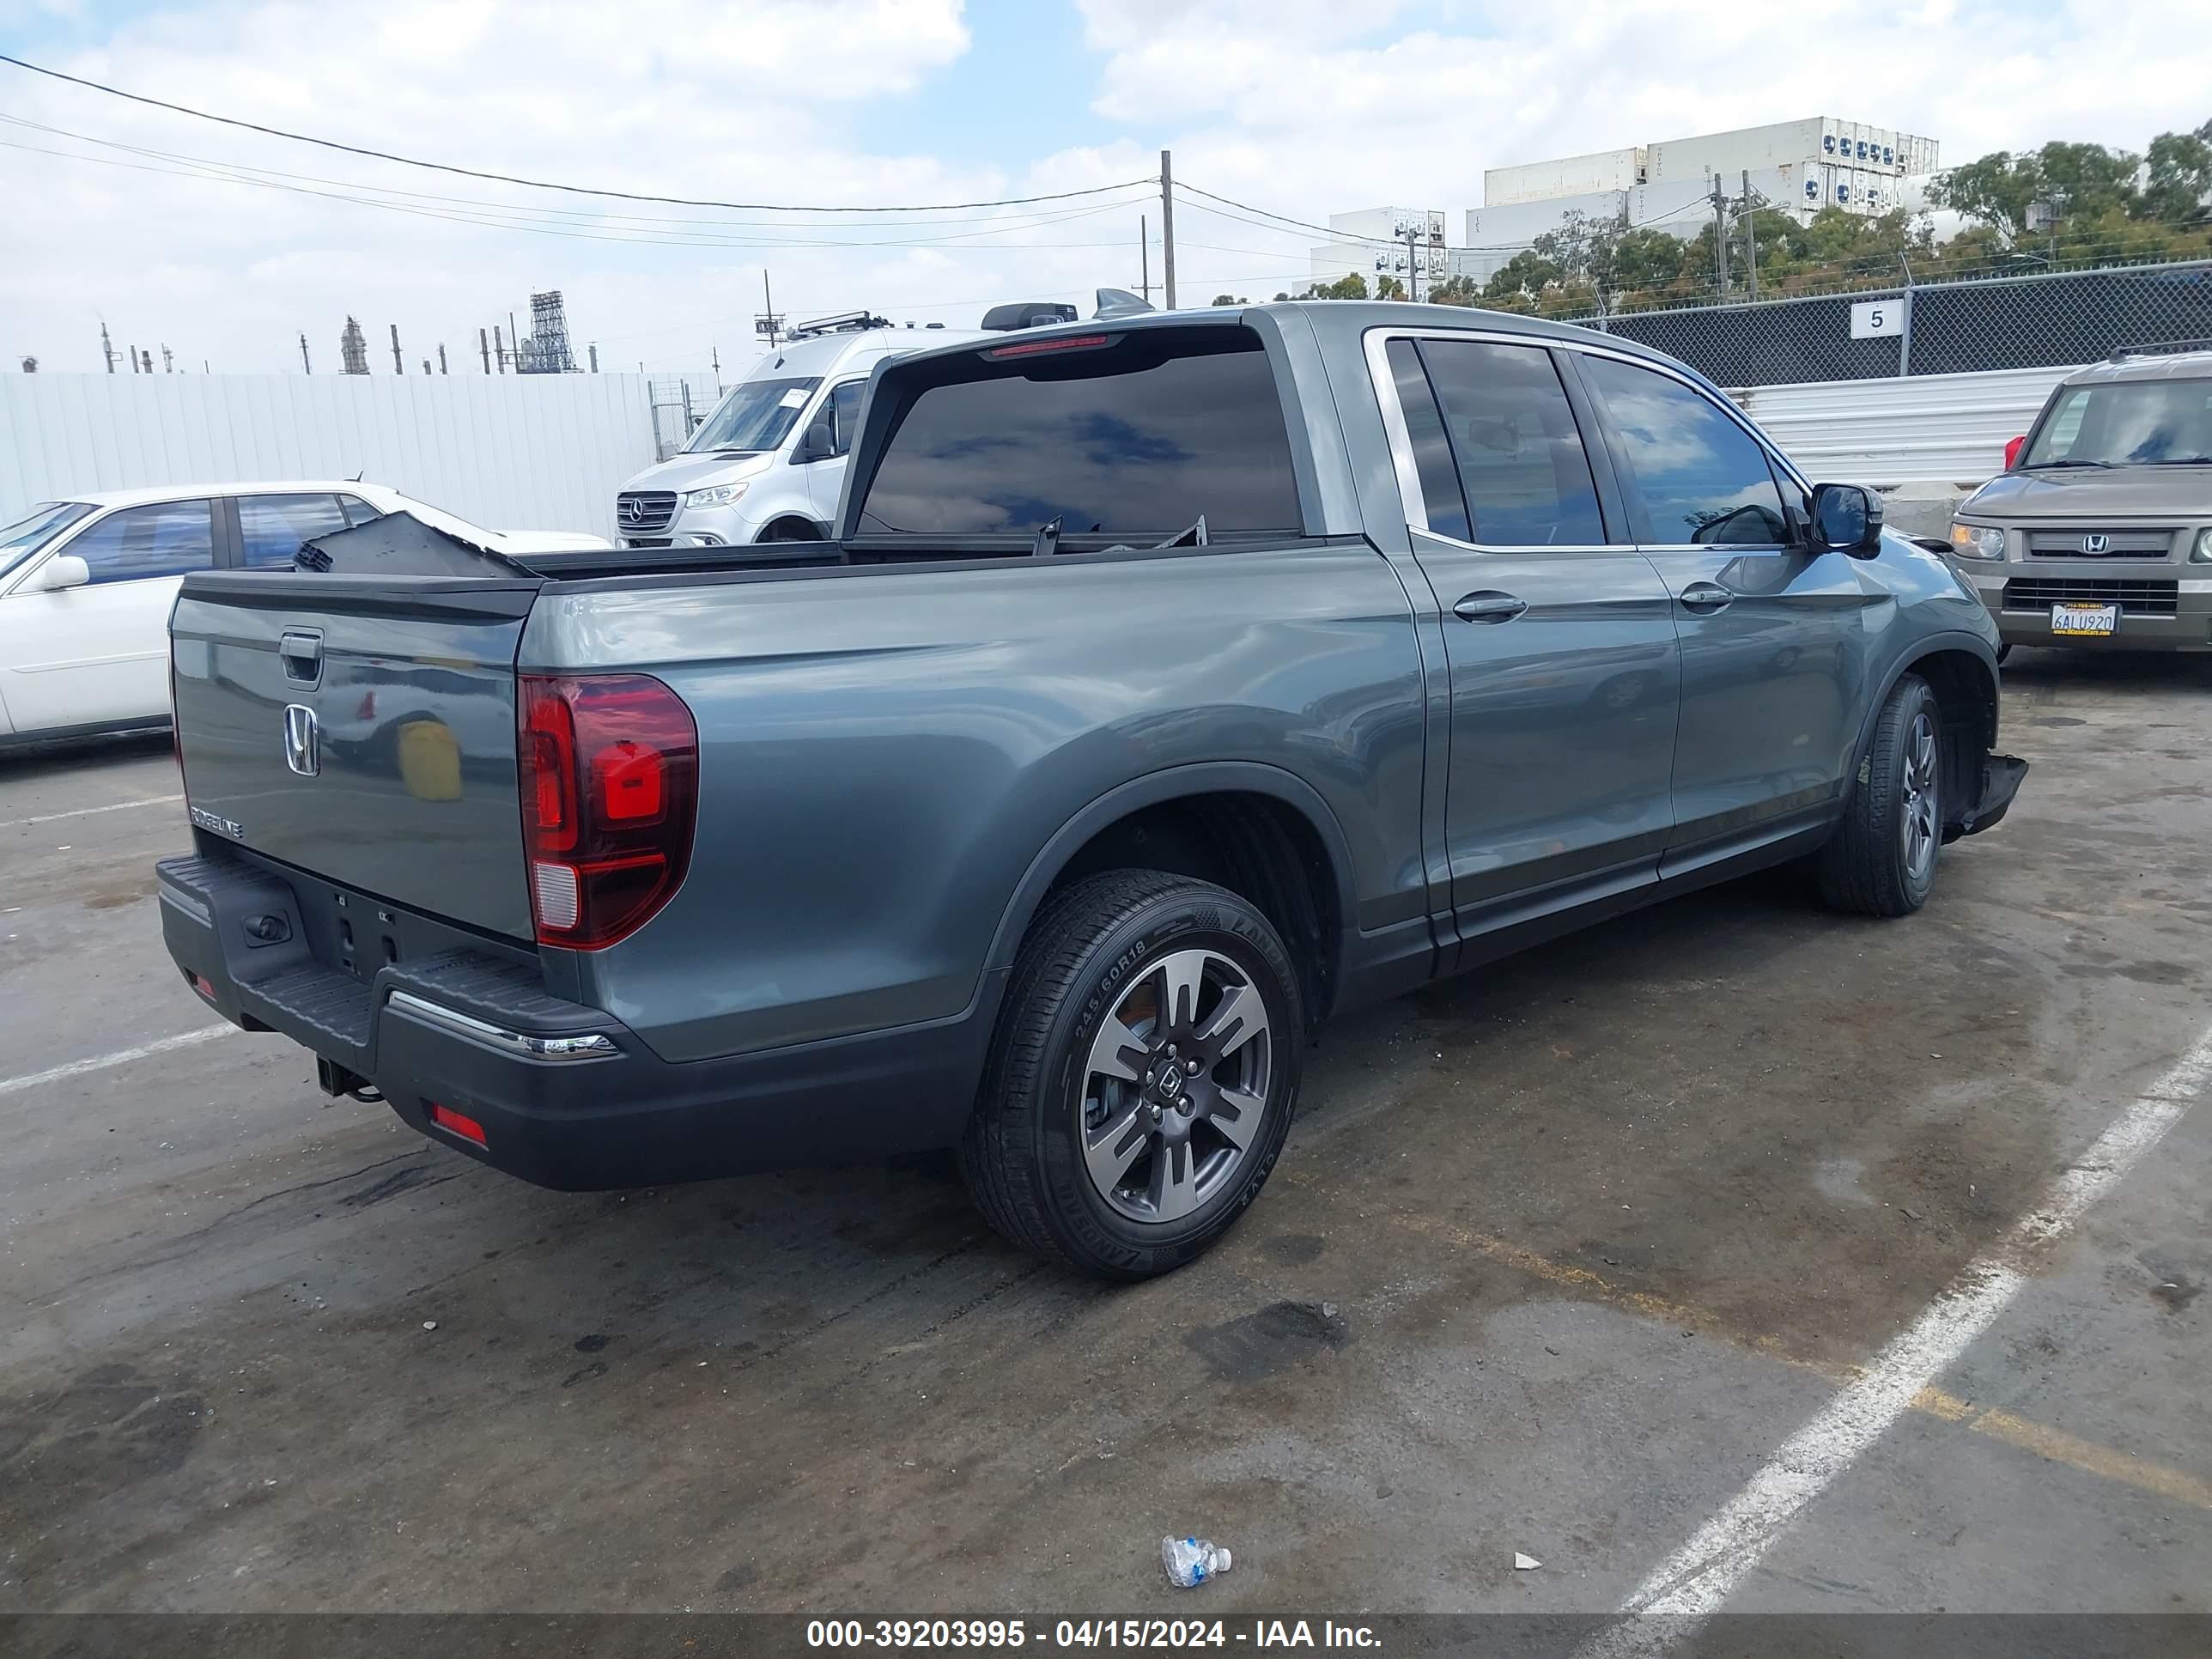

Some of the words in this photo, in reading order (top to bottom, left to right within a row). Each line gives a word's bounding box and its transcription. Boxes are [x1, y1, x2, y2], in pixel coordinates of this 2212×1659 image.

[1871, 310, 1884, 328] 5
[2055, 615, 2112, 629] 6ALU920
[1075, 940, 1146, 1038] 245/60R18
